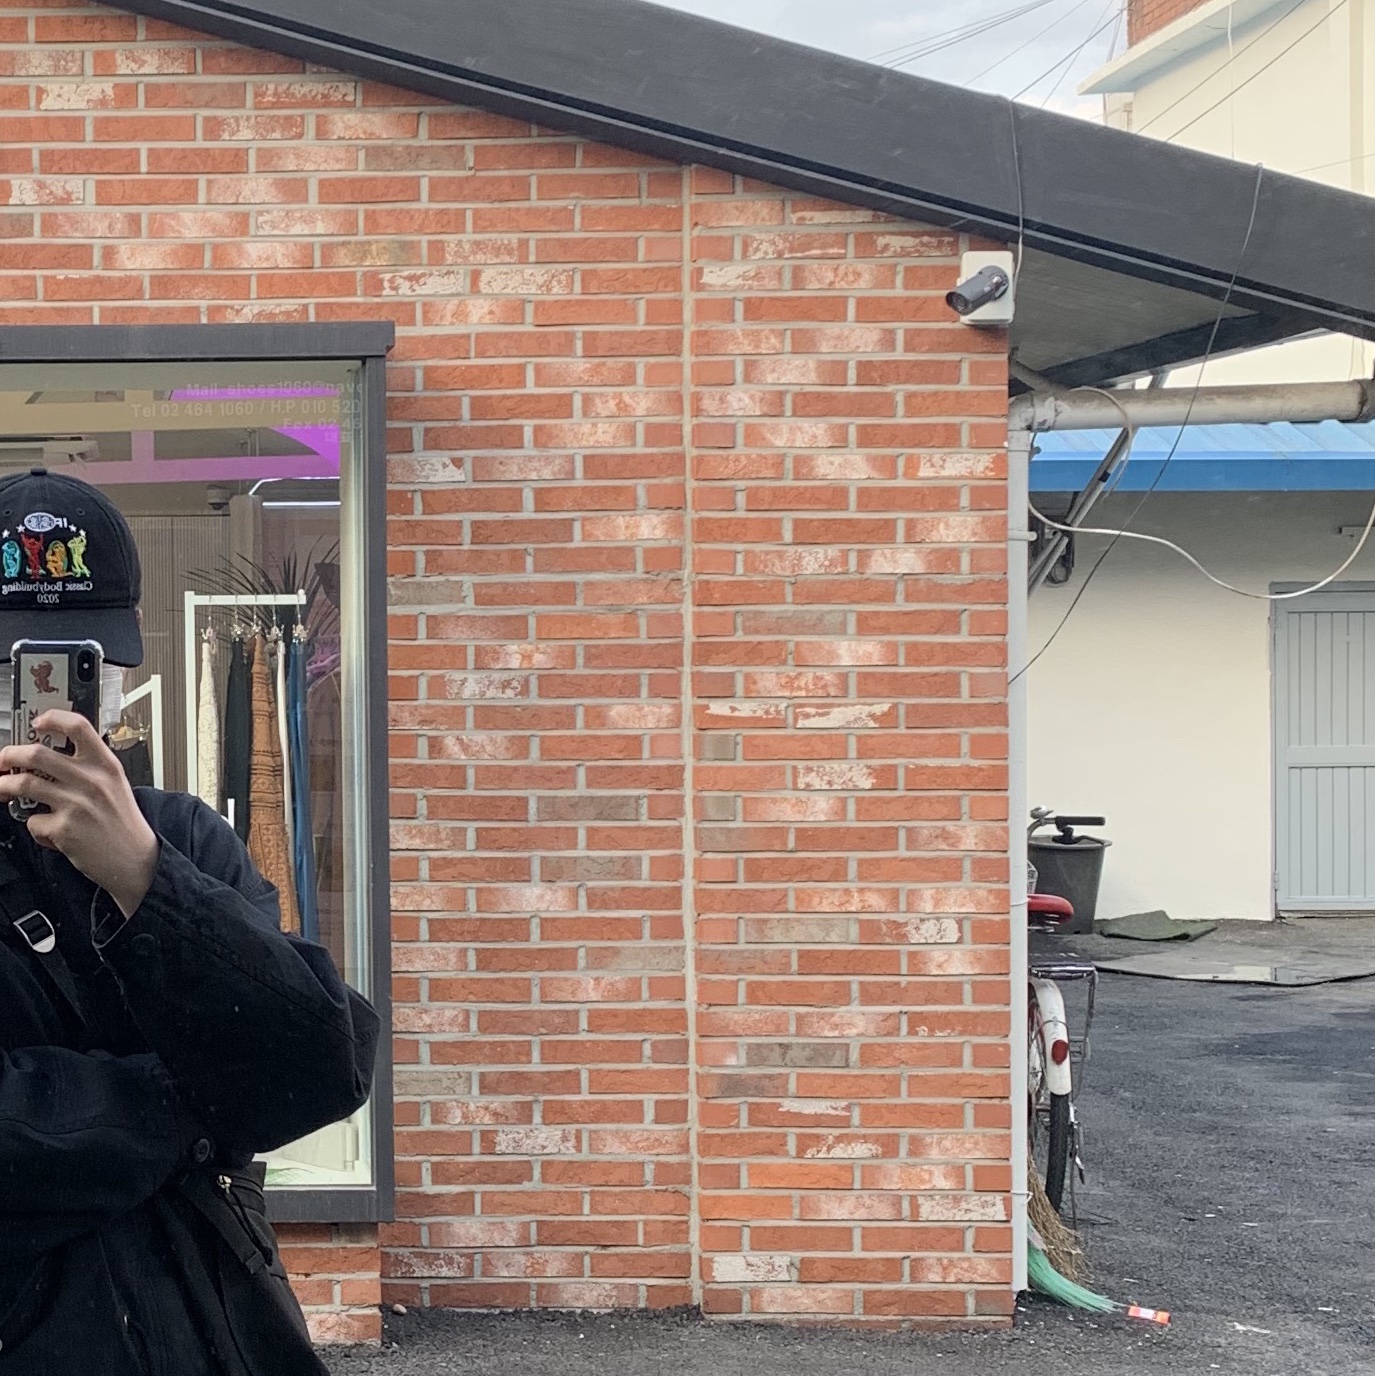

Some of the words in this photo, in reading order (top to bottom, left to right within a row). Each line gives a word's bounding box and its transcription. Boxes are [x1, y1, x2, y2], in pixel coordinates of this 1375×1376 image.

[131, 403, 155, 418] Tel
[161, 403, 179, 417] 02
[184, 402, 212, 416] 464
[220, 401, 253, 415] 1060
[302, 400, 326, 414] 010
